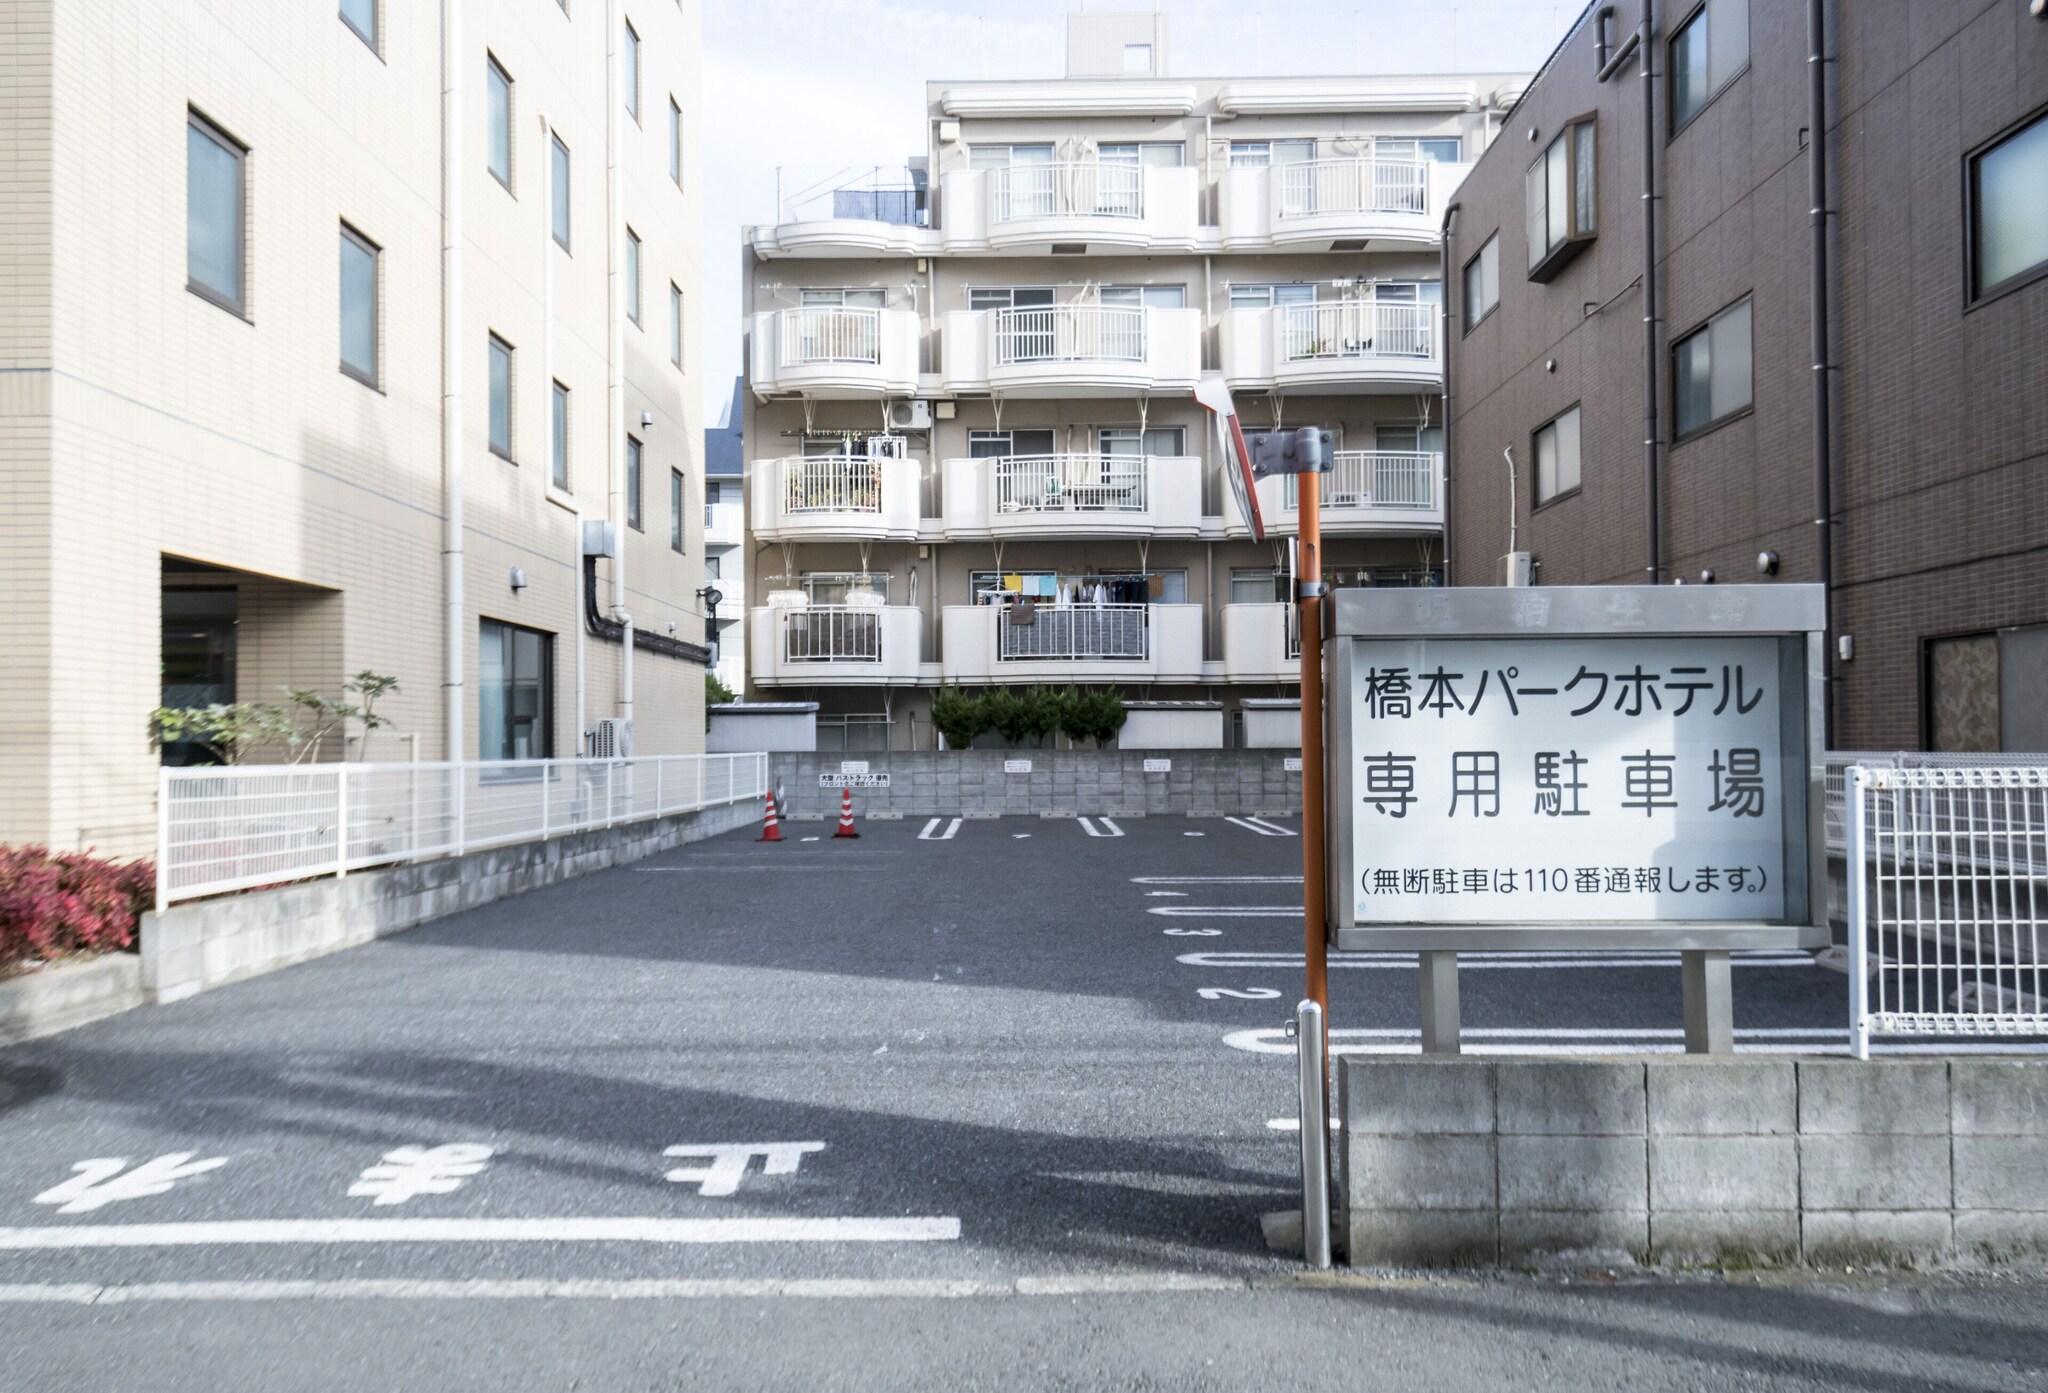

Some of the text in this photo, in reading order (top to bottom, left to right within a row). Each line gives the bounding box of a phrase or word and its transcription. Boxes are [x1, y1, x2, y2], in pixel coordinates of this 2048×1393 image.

[1364, 665, 1764, 719] 橋本パークホテル
[1363, 748, 1765, 818] 専用駐車場
[1361, 866, 1768, 895] (無断駐車は110番通報します。)
[1163, 928, 1223, 936] 3
[1196, 987, 1282, 1000] 2
